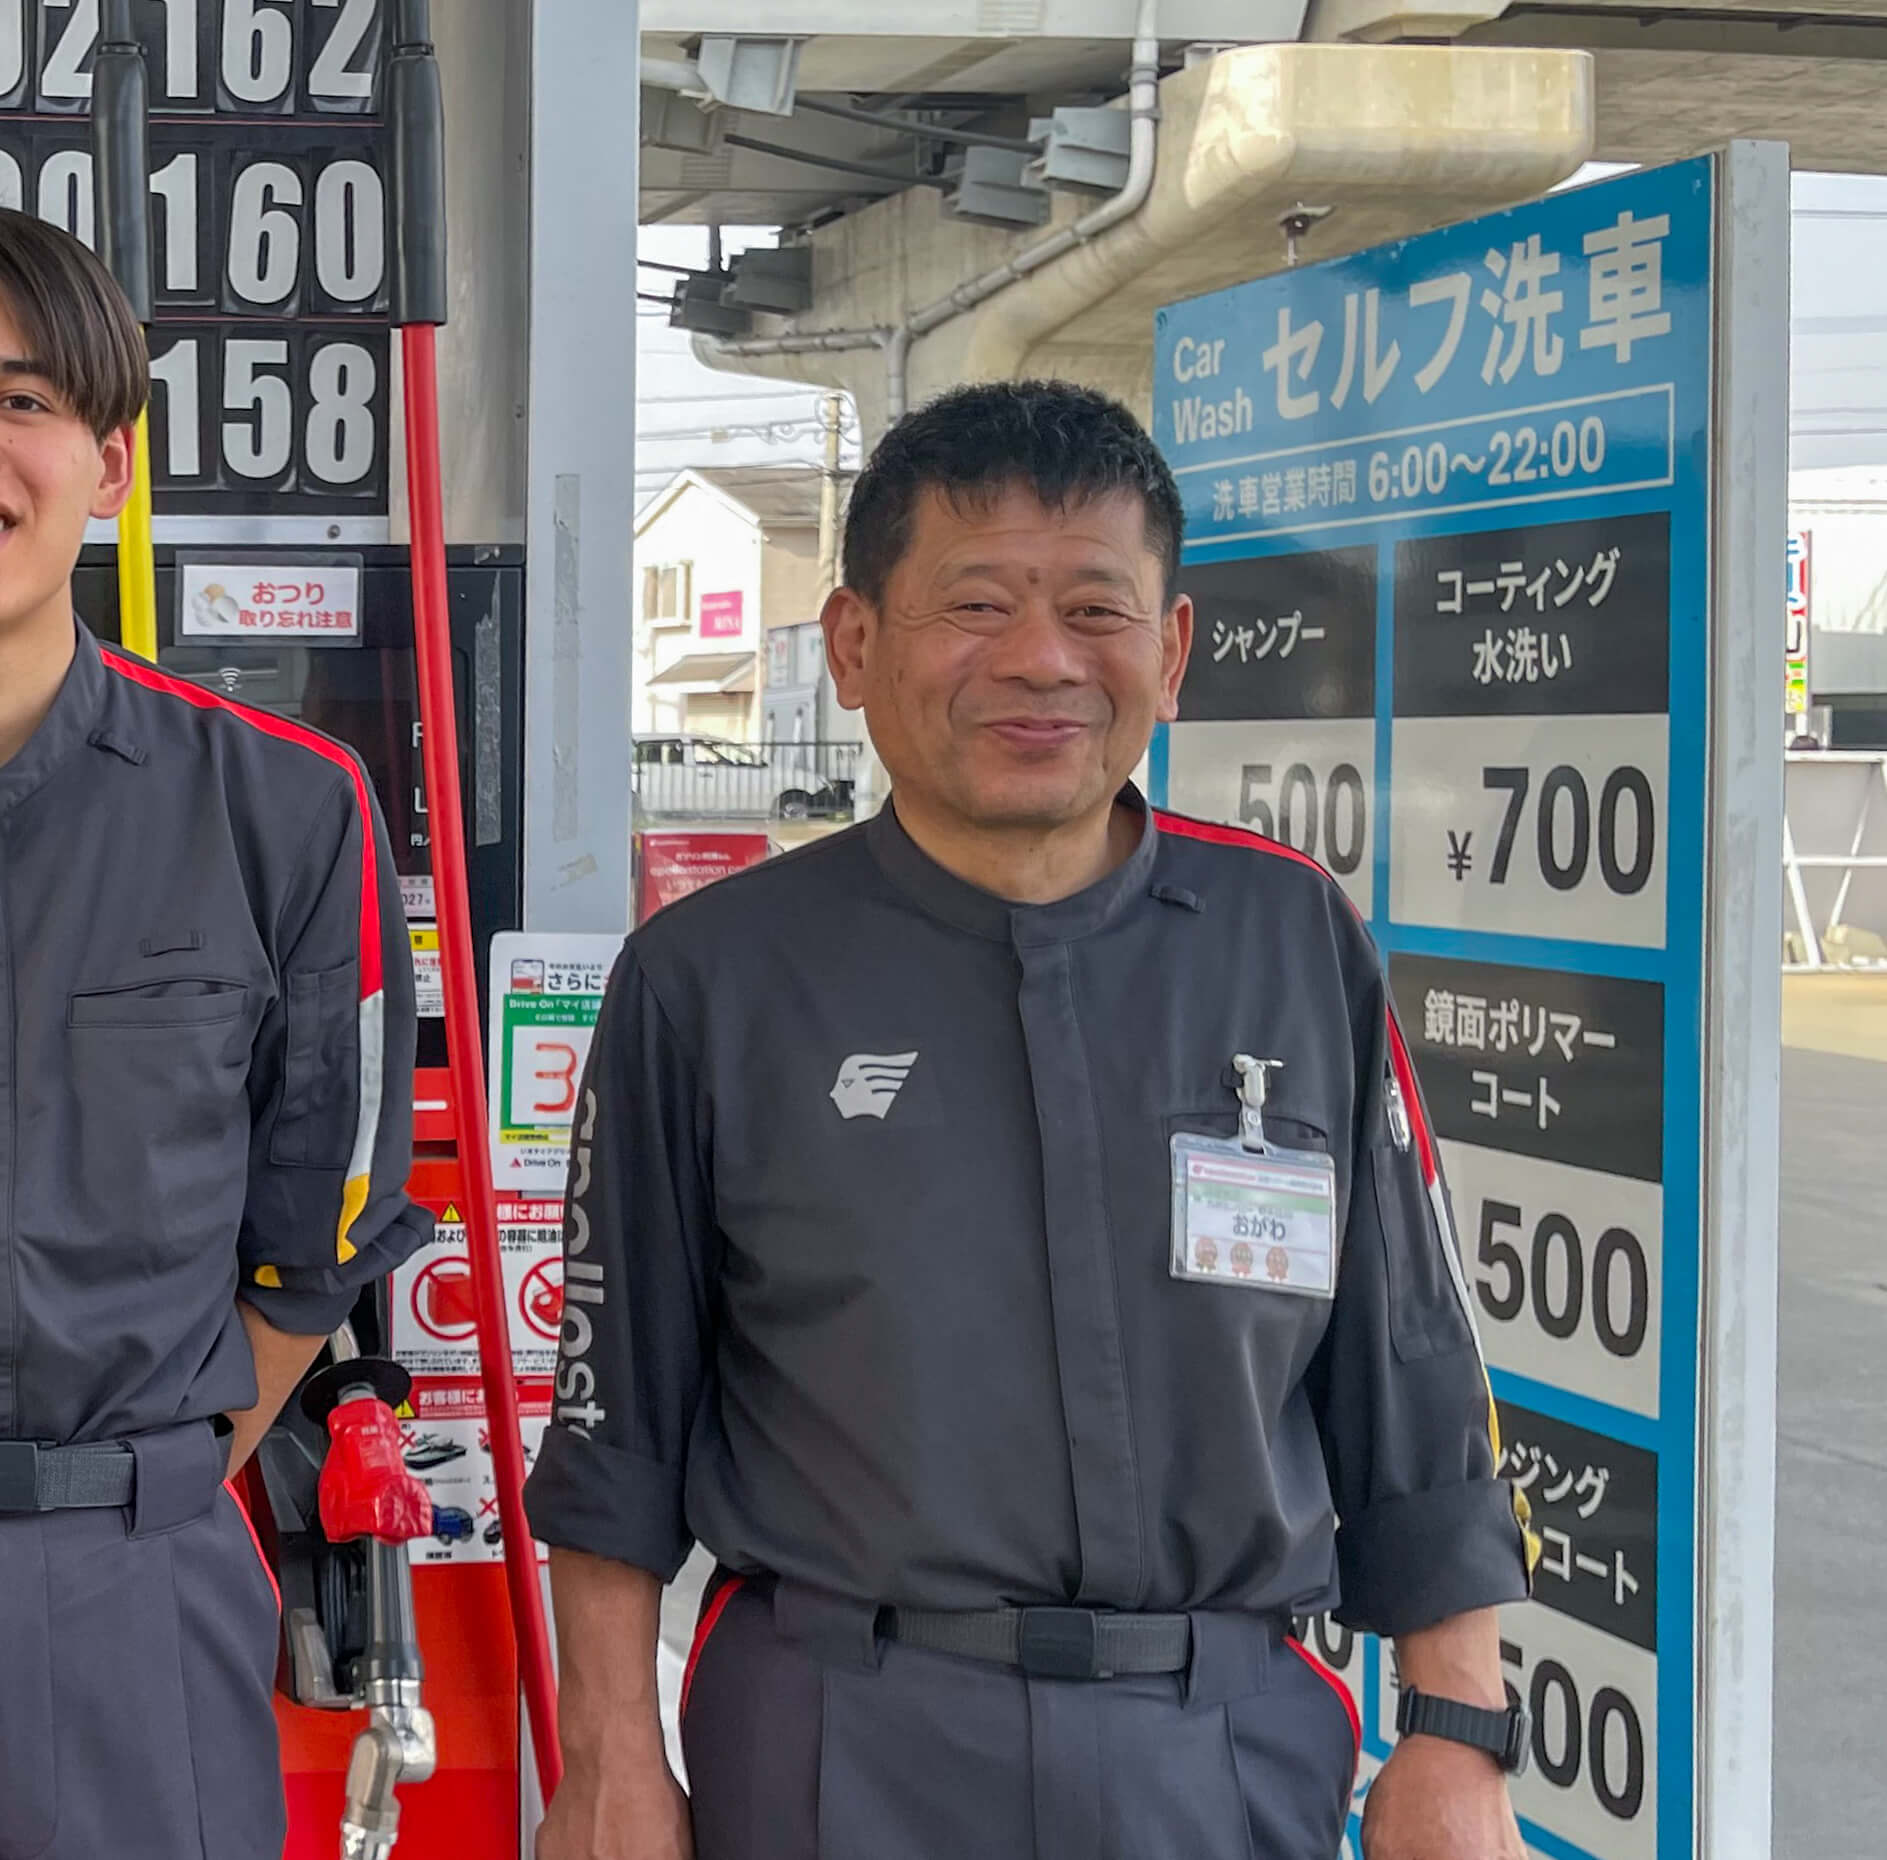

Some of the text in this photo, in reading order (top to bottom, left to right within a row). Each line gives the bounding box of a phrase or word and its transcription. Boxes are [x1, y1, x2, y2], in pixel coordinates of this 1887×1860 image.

[149, 153, 384, 303] 160
[1262, 210, 1671, 420] セルフ洗車
[1172, 334, 1226, 384] Car
[149, 339, 376, 484] 158
[1172, 388, 1253, 446] Wash
[1213, 459, 1356, 521] 洗車営業時間
[251, 582, 325, 605] おつり
[1437, 548, 1621, 614] コーティング
[238, 609, 352, 630] 取り忘れ注意
[1211, 609, 1325, 662] シャンプー
[1472, 627, 1572, 684] 水洗い
[547, 972, 601, 991] さらに
[1424, 987, 1617, 1064] 鏡面ポリマー
[1470, 1070, 1561, 1131] コート
[1475, 1198, 1649, 1358] 500
[1498, 1441, 1610, 1519] ジング
[1541, 1525, 1639, 1605] コート
